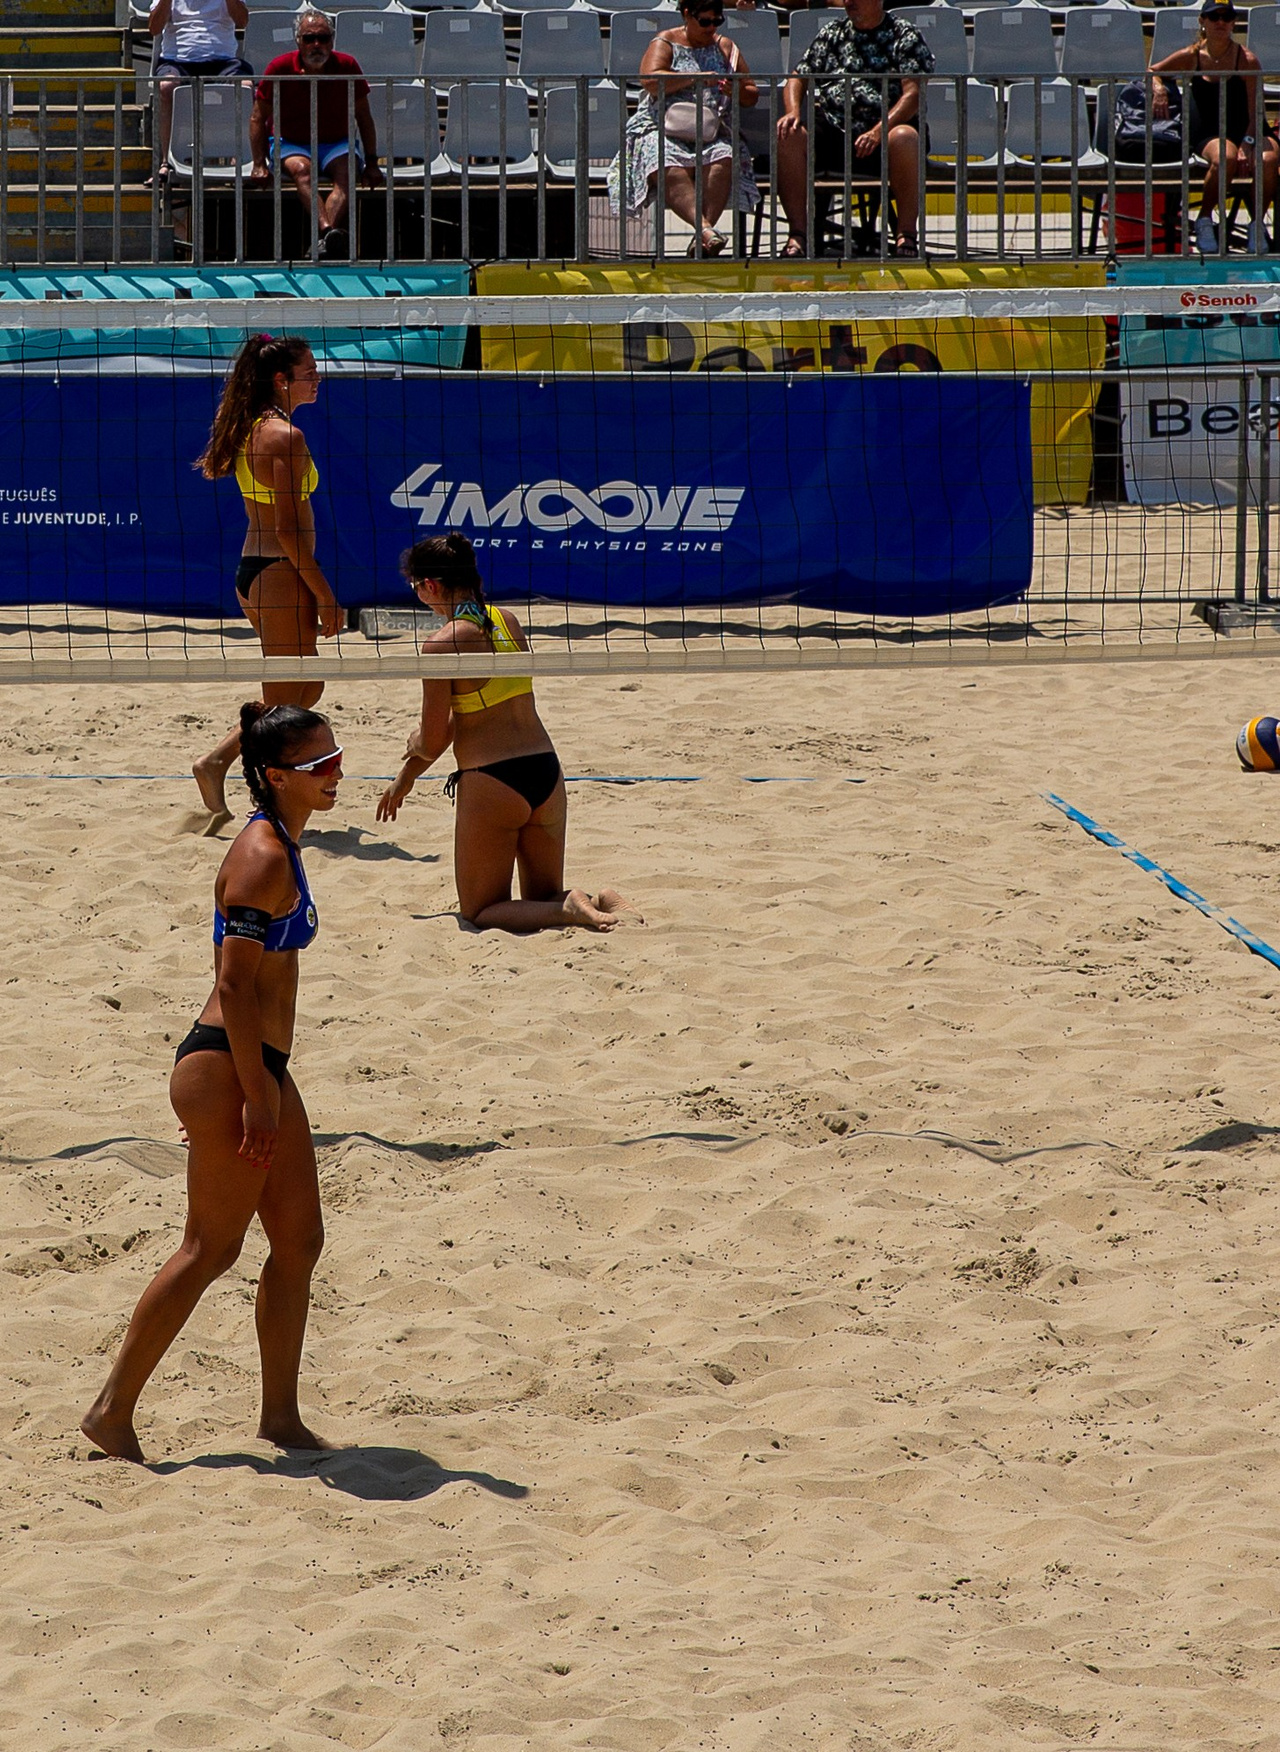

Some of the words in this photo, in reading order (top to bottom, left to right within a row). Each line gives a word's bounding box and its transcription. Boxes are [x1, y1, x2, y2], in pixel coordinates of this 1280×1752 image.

[1198, 294, 1257, 307] Senoh
[2, 512, 10, 525] E
[14, 512, 111, 526] JUVENTUDE,
[559, 540, 648, 551] PHYSIO
[661, 542, 724, 551] ZONE
